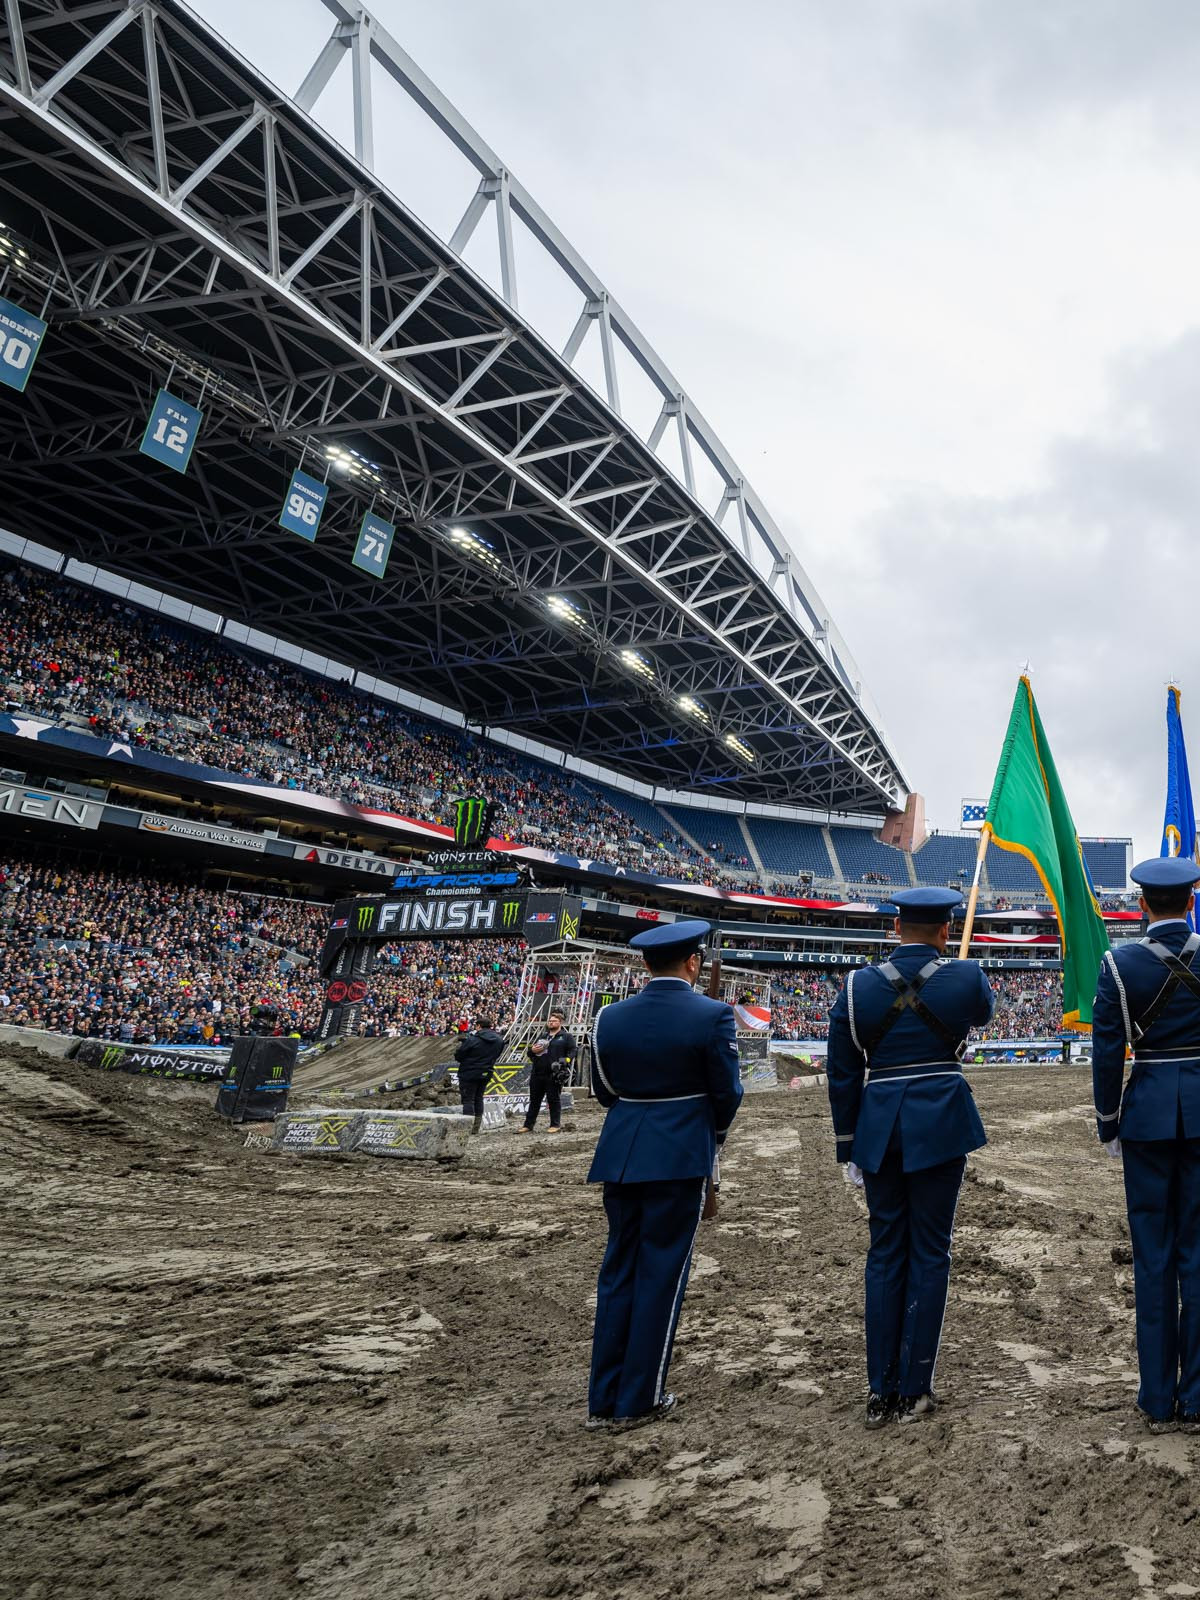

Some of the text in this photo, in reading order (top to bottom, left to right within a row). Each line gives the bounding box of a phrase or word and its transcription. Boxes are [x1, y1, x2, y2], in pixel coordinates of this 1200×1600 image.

[0, 313, 40, 341] RGENT
[166, 407, 188, 424] FAN
[152, 418, 188, 454] 12
[293, 481, 323, 502] KENNEDY
[287, 493, 320, 526] 96
[367, 525, 388, 539] JONES
[361, 534, 385, 563] 71
[145, 816, 168, 827] aws
[170, 823, 265, 850] Amazon Web Services
[326, 851, 387, 874] DELTA
[393, 872, 520, 889] SUPERCROSS
[426, 887, 482, 896] Championship
[377, 900, 497, 933] FINISH
[783, 952, 862, 964] WELCOME
[130, 1053, 226, 1076] MONSTER
[140, 1067, 208, 1082] ENERGY
